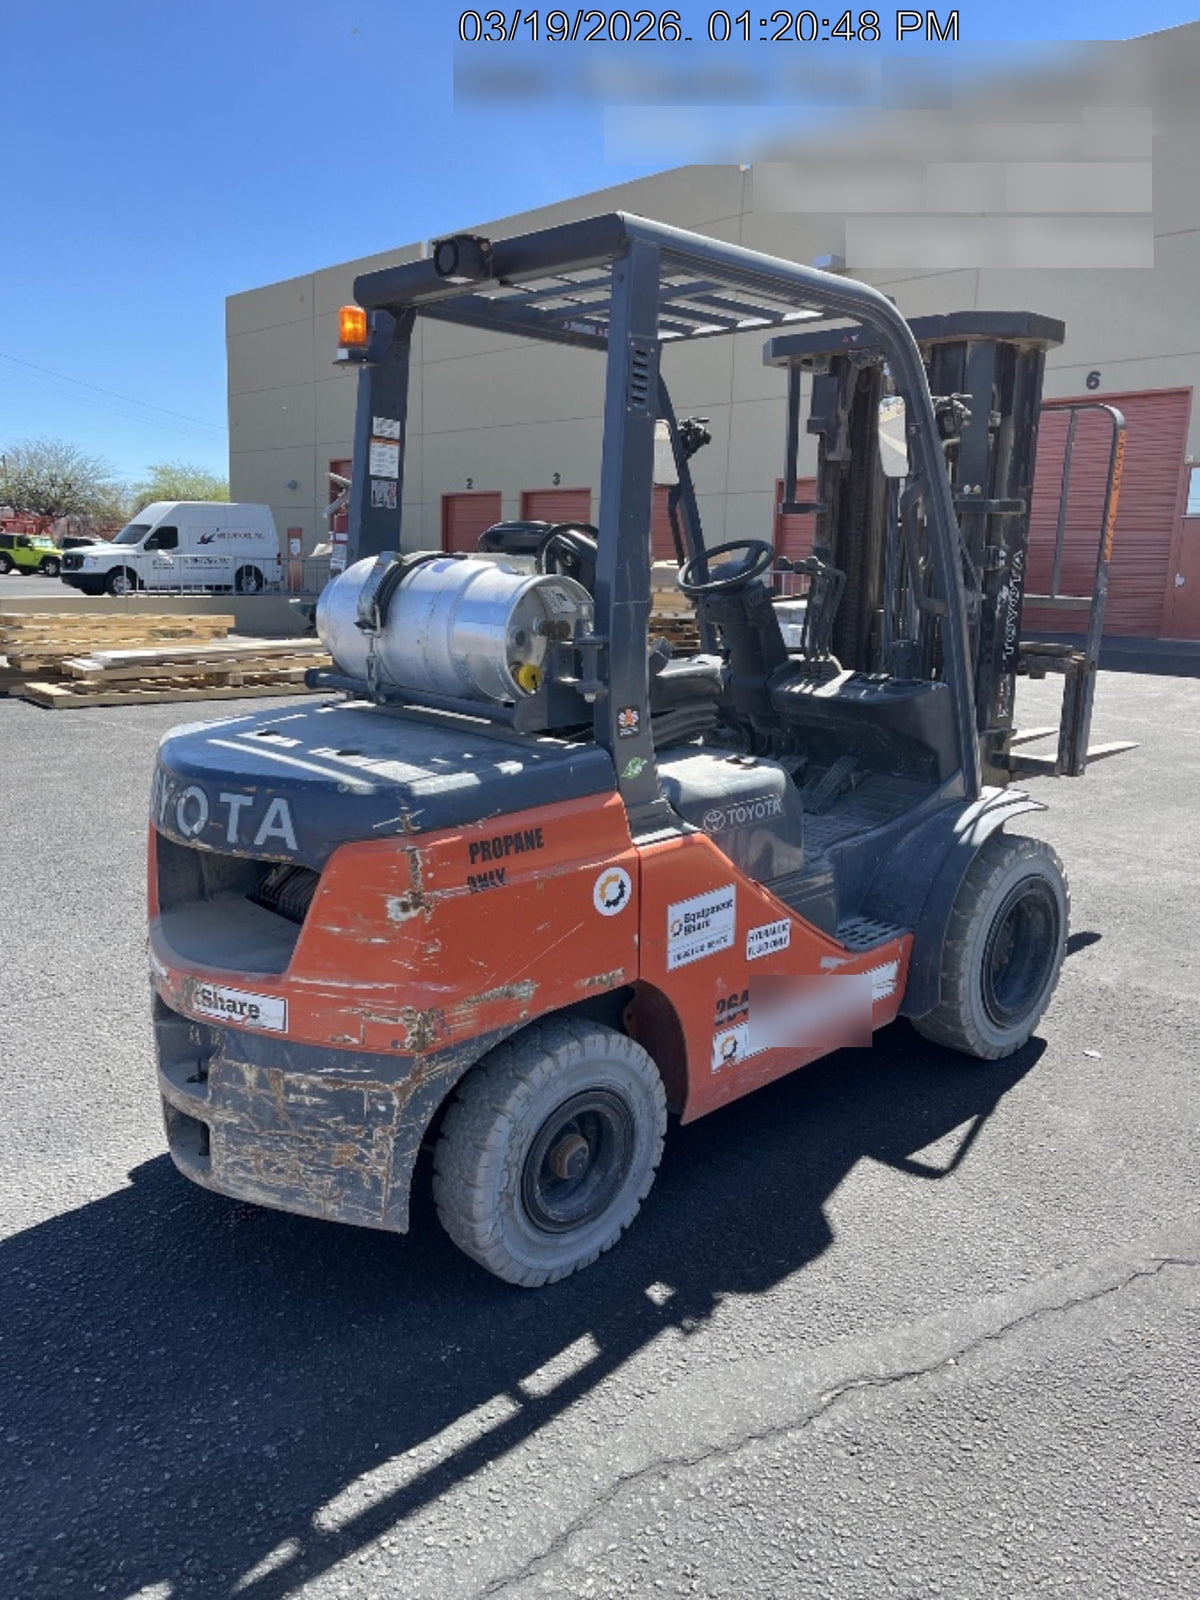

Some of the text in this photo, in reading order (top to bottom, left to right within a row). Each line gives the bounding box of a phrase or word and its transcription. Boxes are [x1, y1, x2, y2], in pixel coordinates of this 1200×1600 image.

[1086, 370, 1101, 390] 6
[466, 477, 474, 490] 2
[552, 472, 561, 487] 3
[151, 767, 299, 850] YOTA
[726, 799, 783, 825] TOYOTA
[468, 827, 545, 865] PROPANE
[195, 987, 261, 1020] Share
